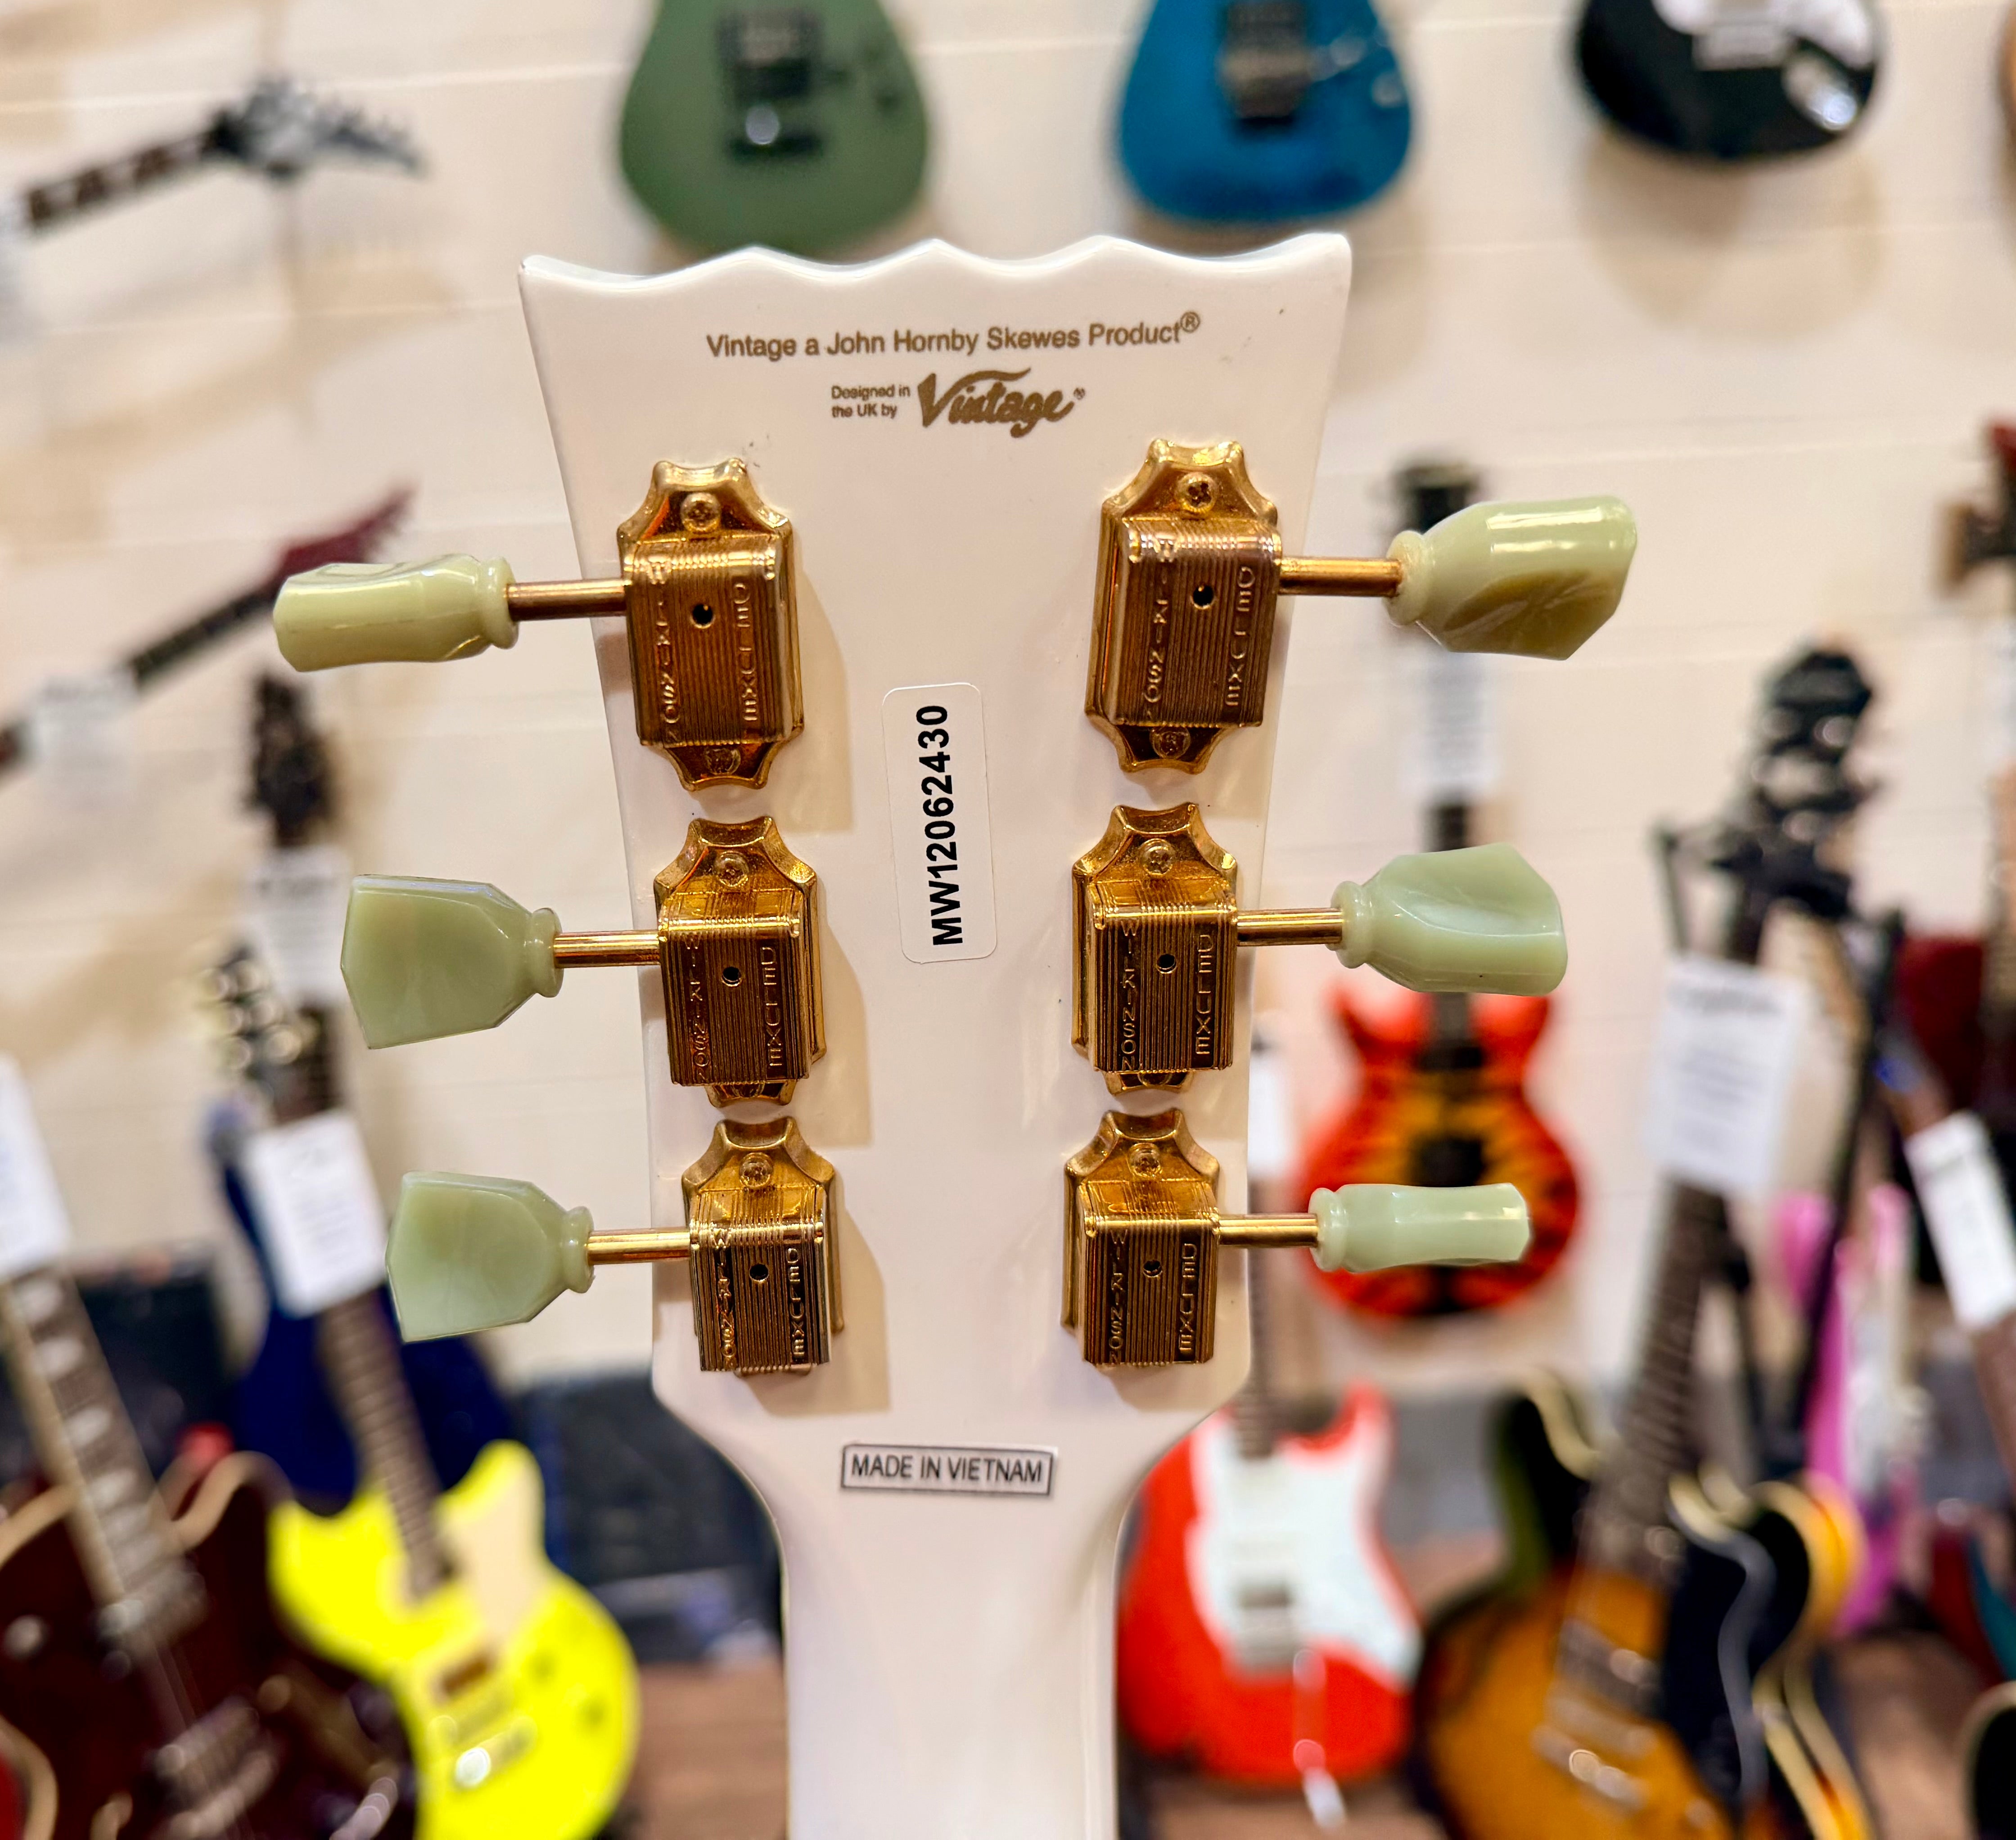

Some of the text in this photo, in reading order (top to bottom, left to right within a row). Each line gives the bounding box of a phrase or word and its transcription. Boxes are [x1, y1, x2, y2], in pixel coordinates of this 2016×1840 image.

[706, 334, 796, 361] Vintage
[805, 338, 820, 355] a
[826, 330, 885, 355] John
[894, 328, 979, 355] Hornby
[987, 326, 1080, 350] Skewes
[831, 384, 910, 400] Designed in
[831, 404, 897, 418] the UK by
[917, 368, 1075, 438] Vintage
[1225, 566, 1255, 706] DELUXE
[916, 705, 963, 945] MW12062430
[760, 946, 782, 1066] DELUXE
[1120, 921, 1139, 1070] WILKINSON
[1195, 934, 1213, 1054] DELUXE
[787, 1248, 805, 1357] DELUXE
[1179, 1243, 1197, 1351] DELUXE
[852, 1453, 1042, 1483] MADE IN VIETNAM
